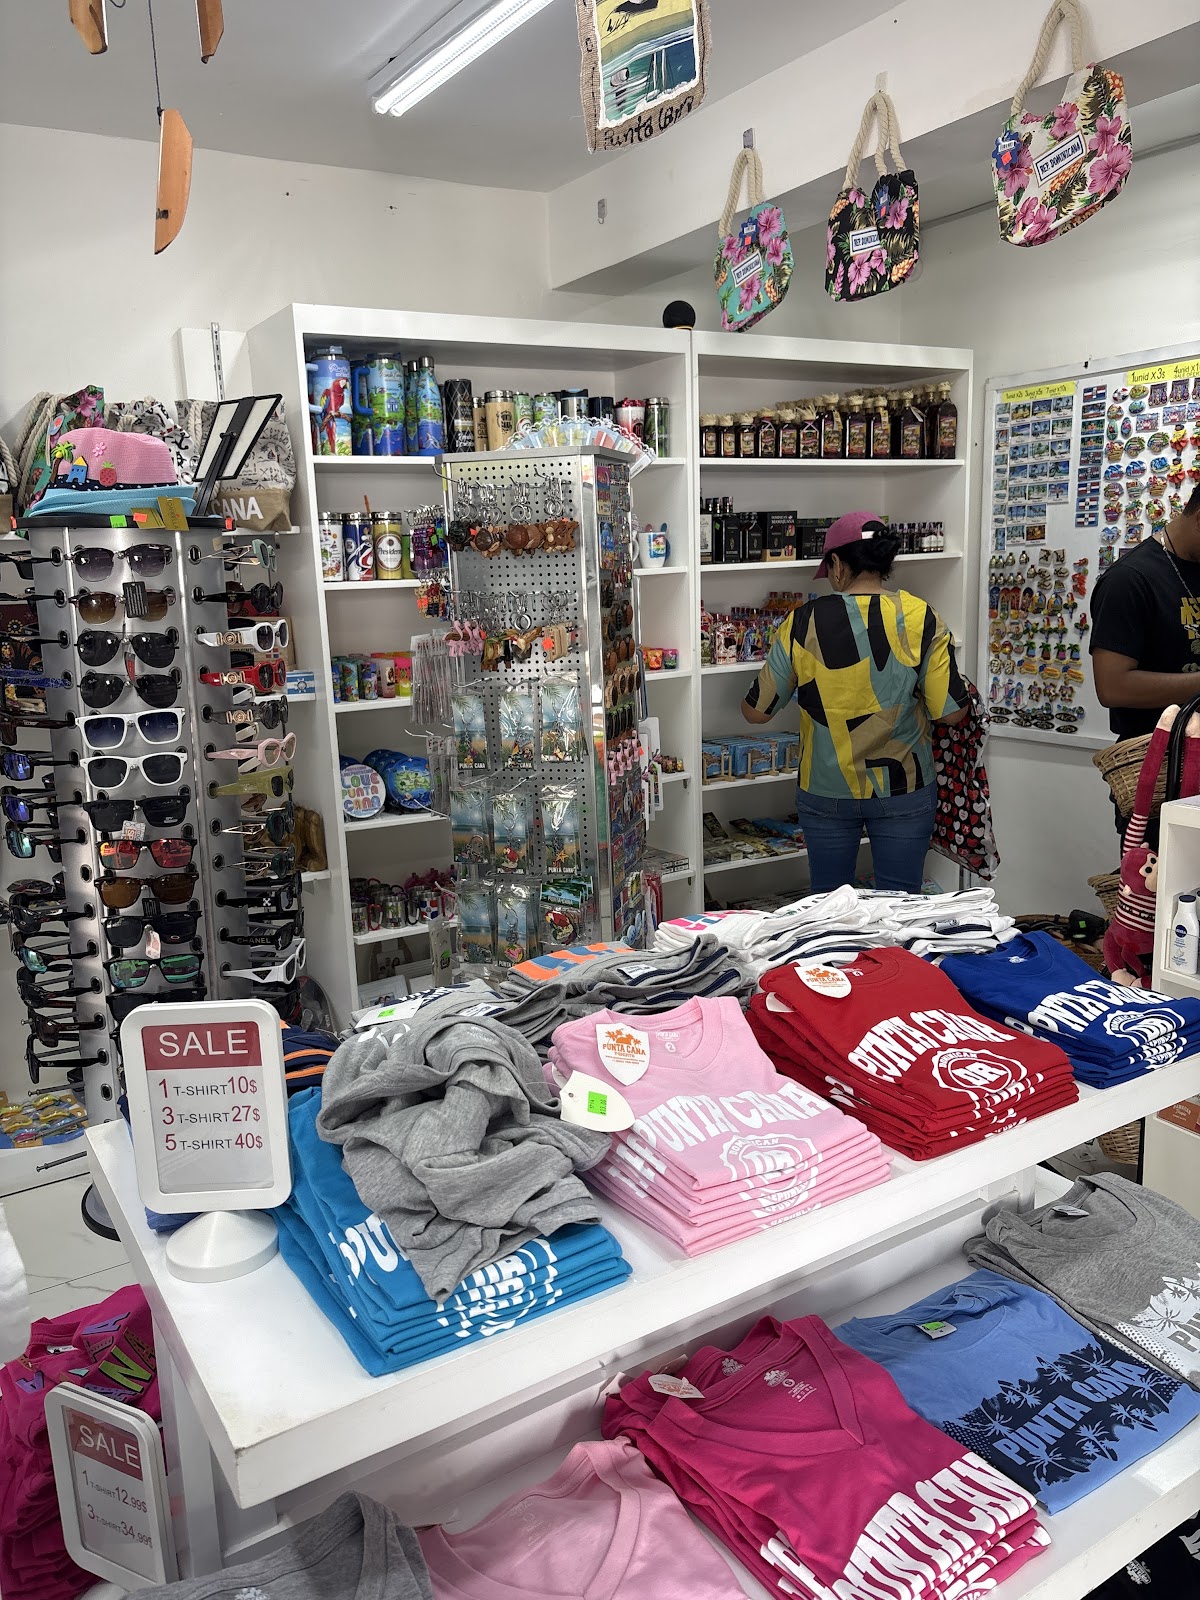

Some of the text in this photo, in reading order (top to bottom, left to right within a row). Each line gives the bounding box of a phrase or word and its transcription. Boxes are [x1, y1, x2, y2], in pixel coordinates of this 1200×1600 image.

[1050, 142, 1081, 168] DOMINICANA
[341, 772, 380, 789] LOVE
[341, 785, 379, 800] PUNTA
[343, 795, 381, 812] CANA
[236, 937, 272, 945] CHANEL
[158, 1029, 249, 1058] SALE
[602, 1043, 647, 1056] PUNTA CANA
[848, 1009, 1017, 1083] PUNTA CANA
[158, 1075, 258, 1099] 1 T-SHIRT 10$
[162, 1105, 261, 1126] 3 T-SHIRT 27$
[632, 1081, 832, 1152] PUNTA CANA
[165, 1132, 264, 1151] 5 T-SHIRT 40$
[991, 1359, 1150, 1466] PUNTA CANA
[78, 1424, 142, 1470] SALE
[82, 1469, 148, 1514] 1 T-SHIRT 12.99$
[87, 1504, 96, 1520] 3
[120, 1520, 154, 1549] 34.99$
